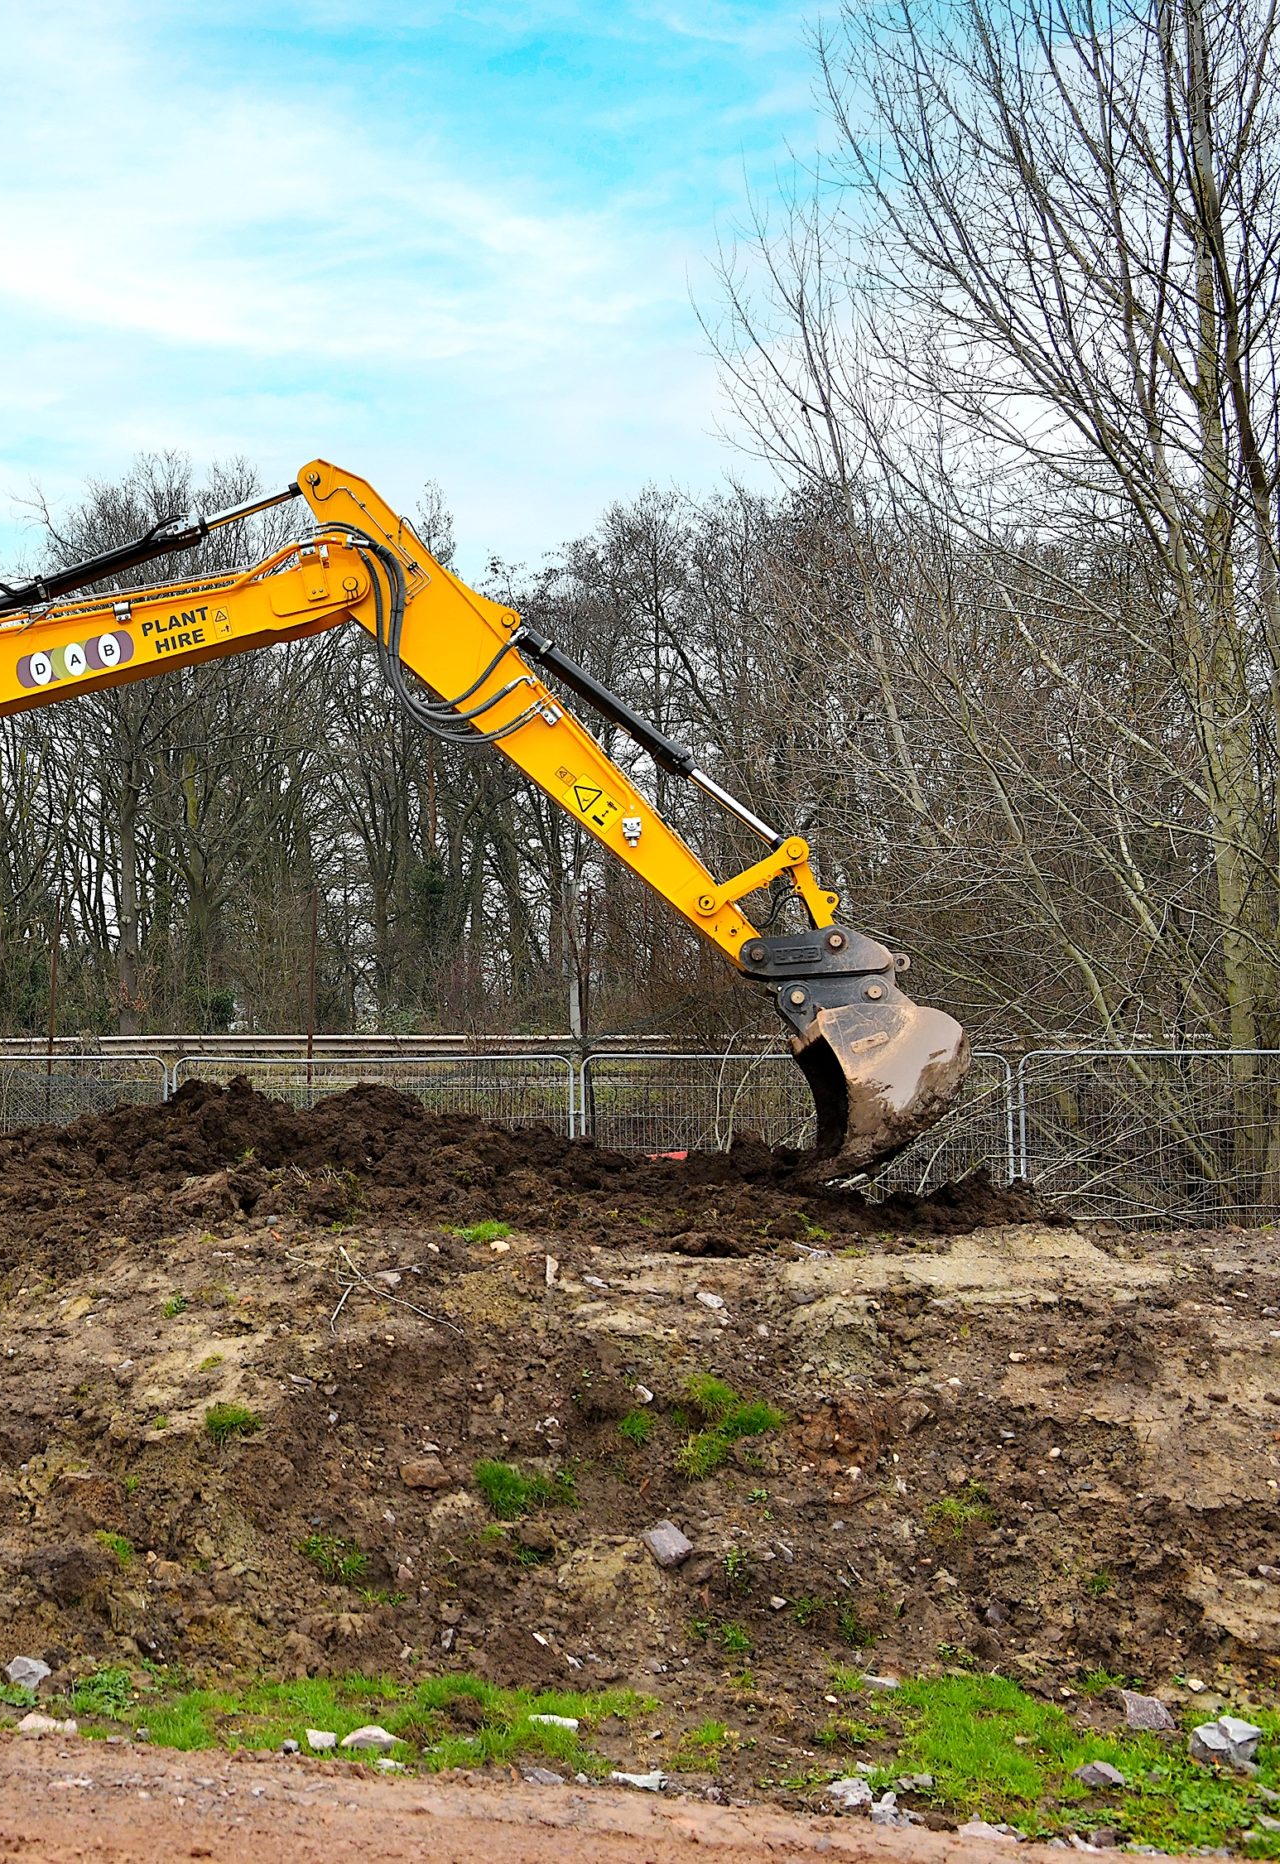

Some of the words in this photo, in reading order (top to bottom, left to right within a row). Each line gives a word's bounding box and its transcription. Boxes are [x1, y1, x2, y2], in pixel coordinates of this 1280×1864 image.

[141, 606, 209, 637] PLANT
[155, 629, 206, 655] HIRE
[774, 948, 820, 961] JCB
